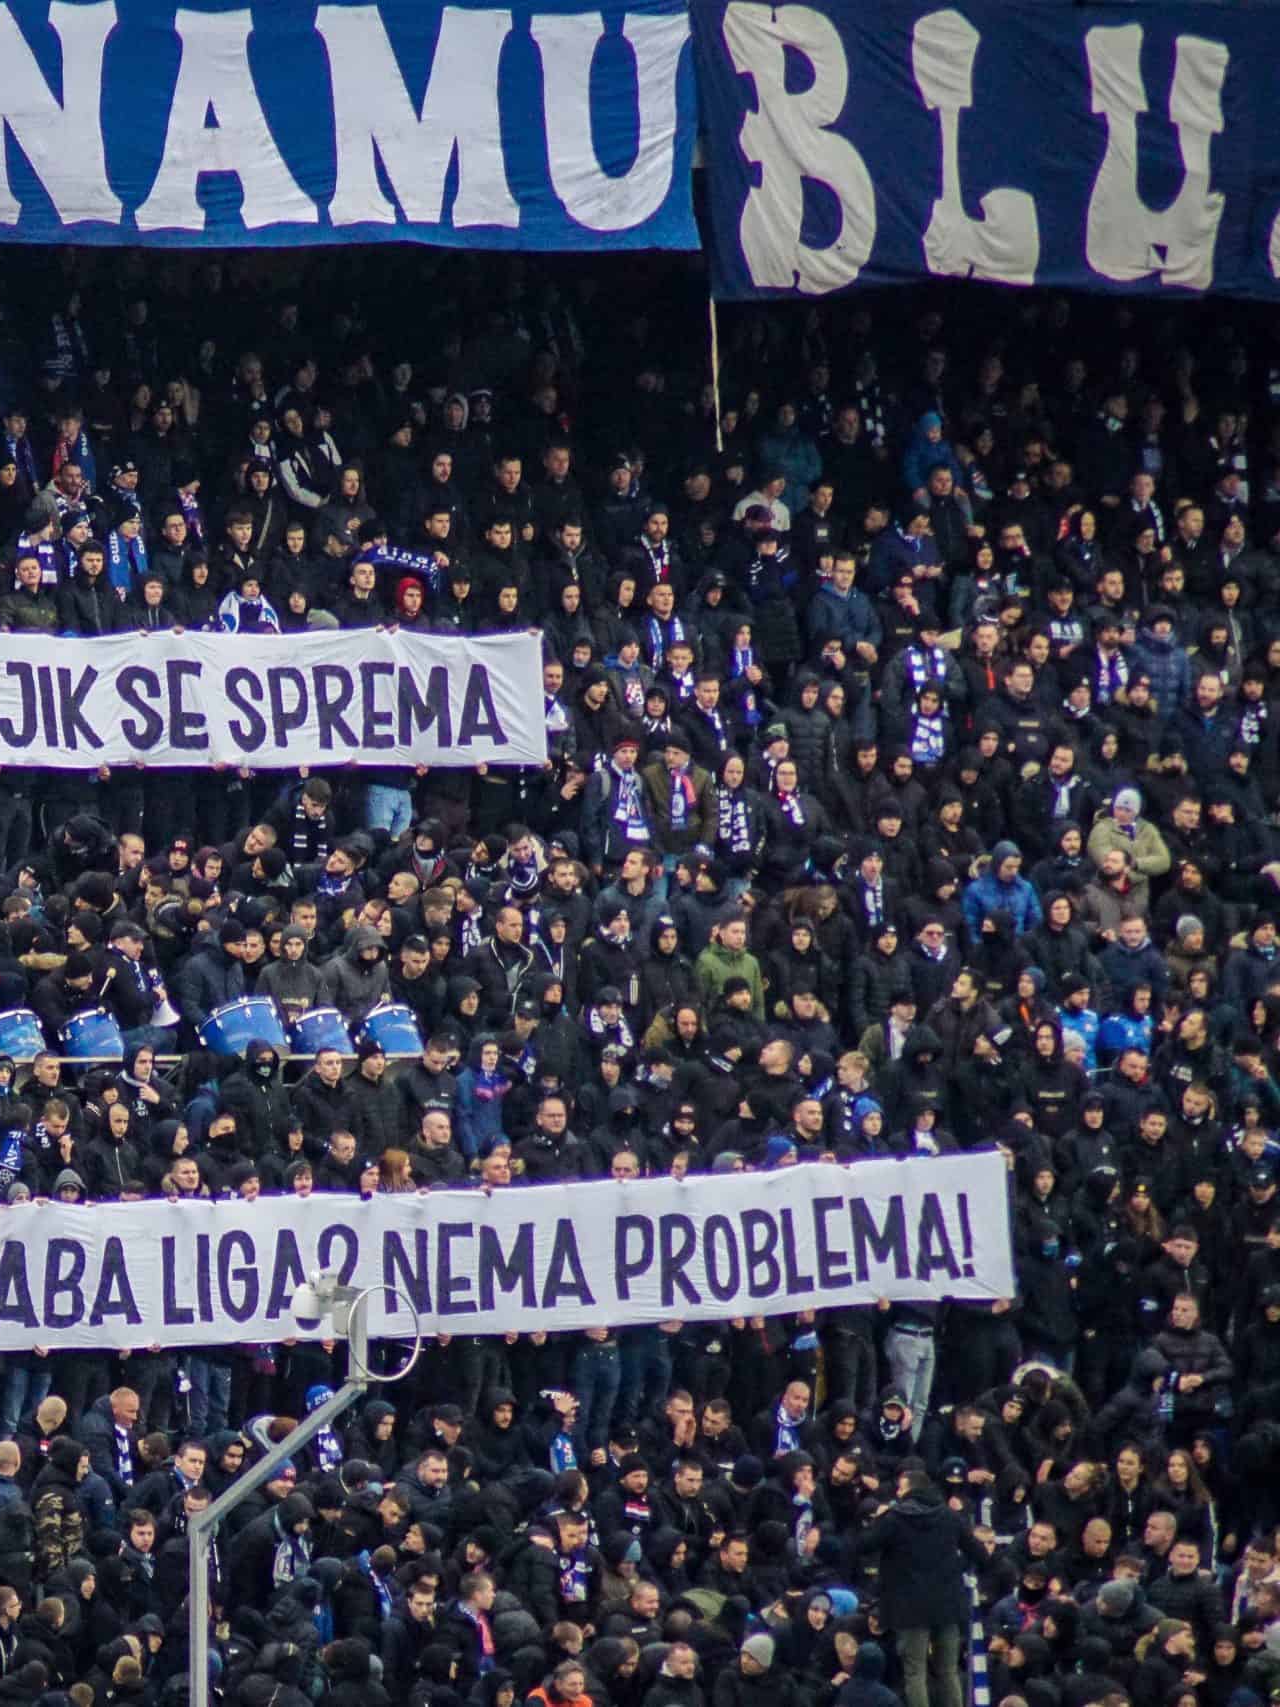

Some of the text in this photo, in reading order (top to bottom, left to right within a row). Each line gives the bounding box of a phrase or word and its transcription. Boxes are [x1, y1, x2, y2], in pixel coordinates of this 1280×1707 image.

[723, 2, 1280, 295] BLU
[120, 660, 209, 750] SE
[226, 661, 508, 752] SPREMA
[382, 1218, 595, 1315] NEMA
[614, 1193, 975, 1306] PROBLEMA!
